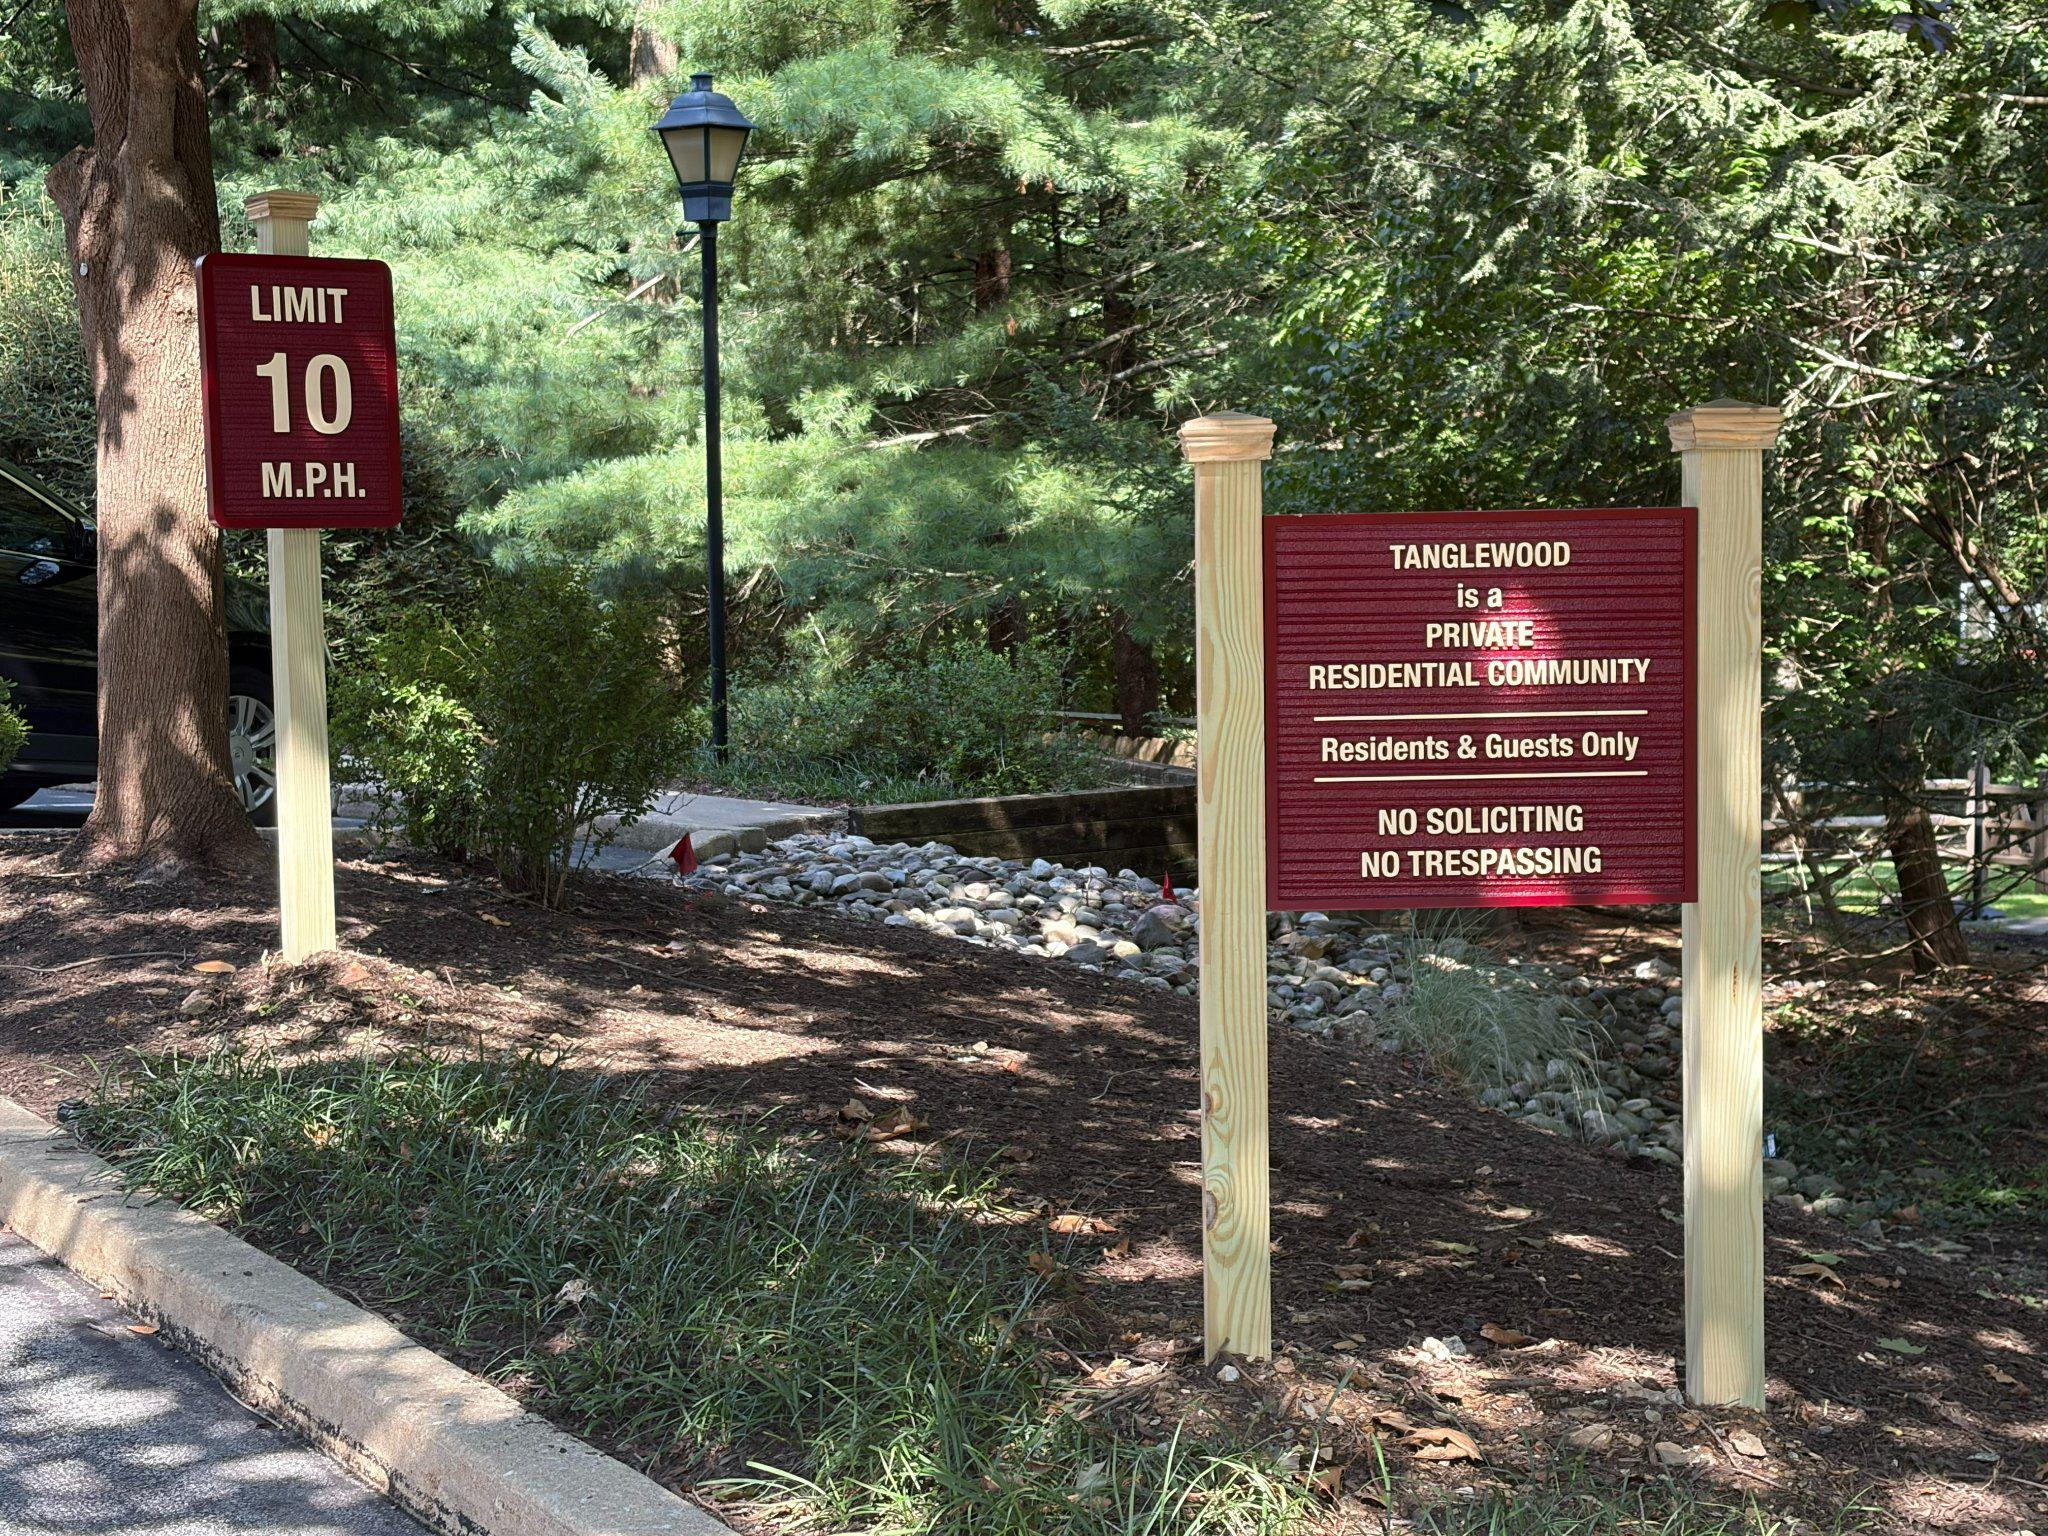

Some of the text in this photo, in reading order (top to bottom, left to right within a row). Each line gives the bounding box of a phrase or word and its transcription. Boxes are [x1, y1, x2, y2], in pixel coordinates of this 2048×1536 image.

[250, 285, 347, 323] LIMIT
[256, 352, 352, 435] 10
[261, 461, 366, 499] M.P.H.
[1390, 540, 1571, 570] TANGLEWOOD
[1456, 583, 1503, 609] is a
[1426, 620, 1535, 649] PRIVATE
[1309, 658, 1651, 690] RESIDENTIAL COMMUNITY
[1322, 731, 1640, 762] Residents & Guests Only
[1378, 804, 1584, 836] NO SOLICITING
[1361, 846, 1602, 878] NO TRESPASSING
